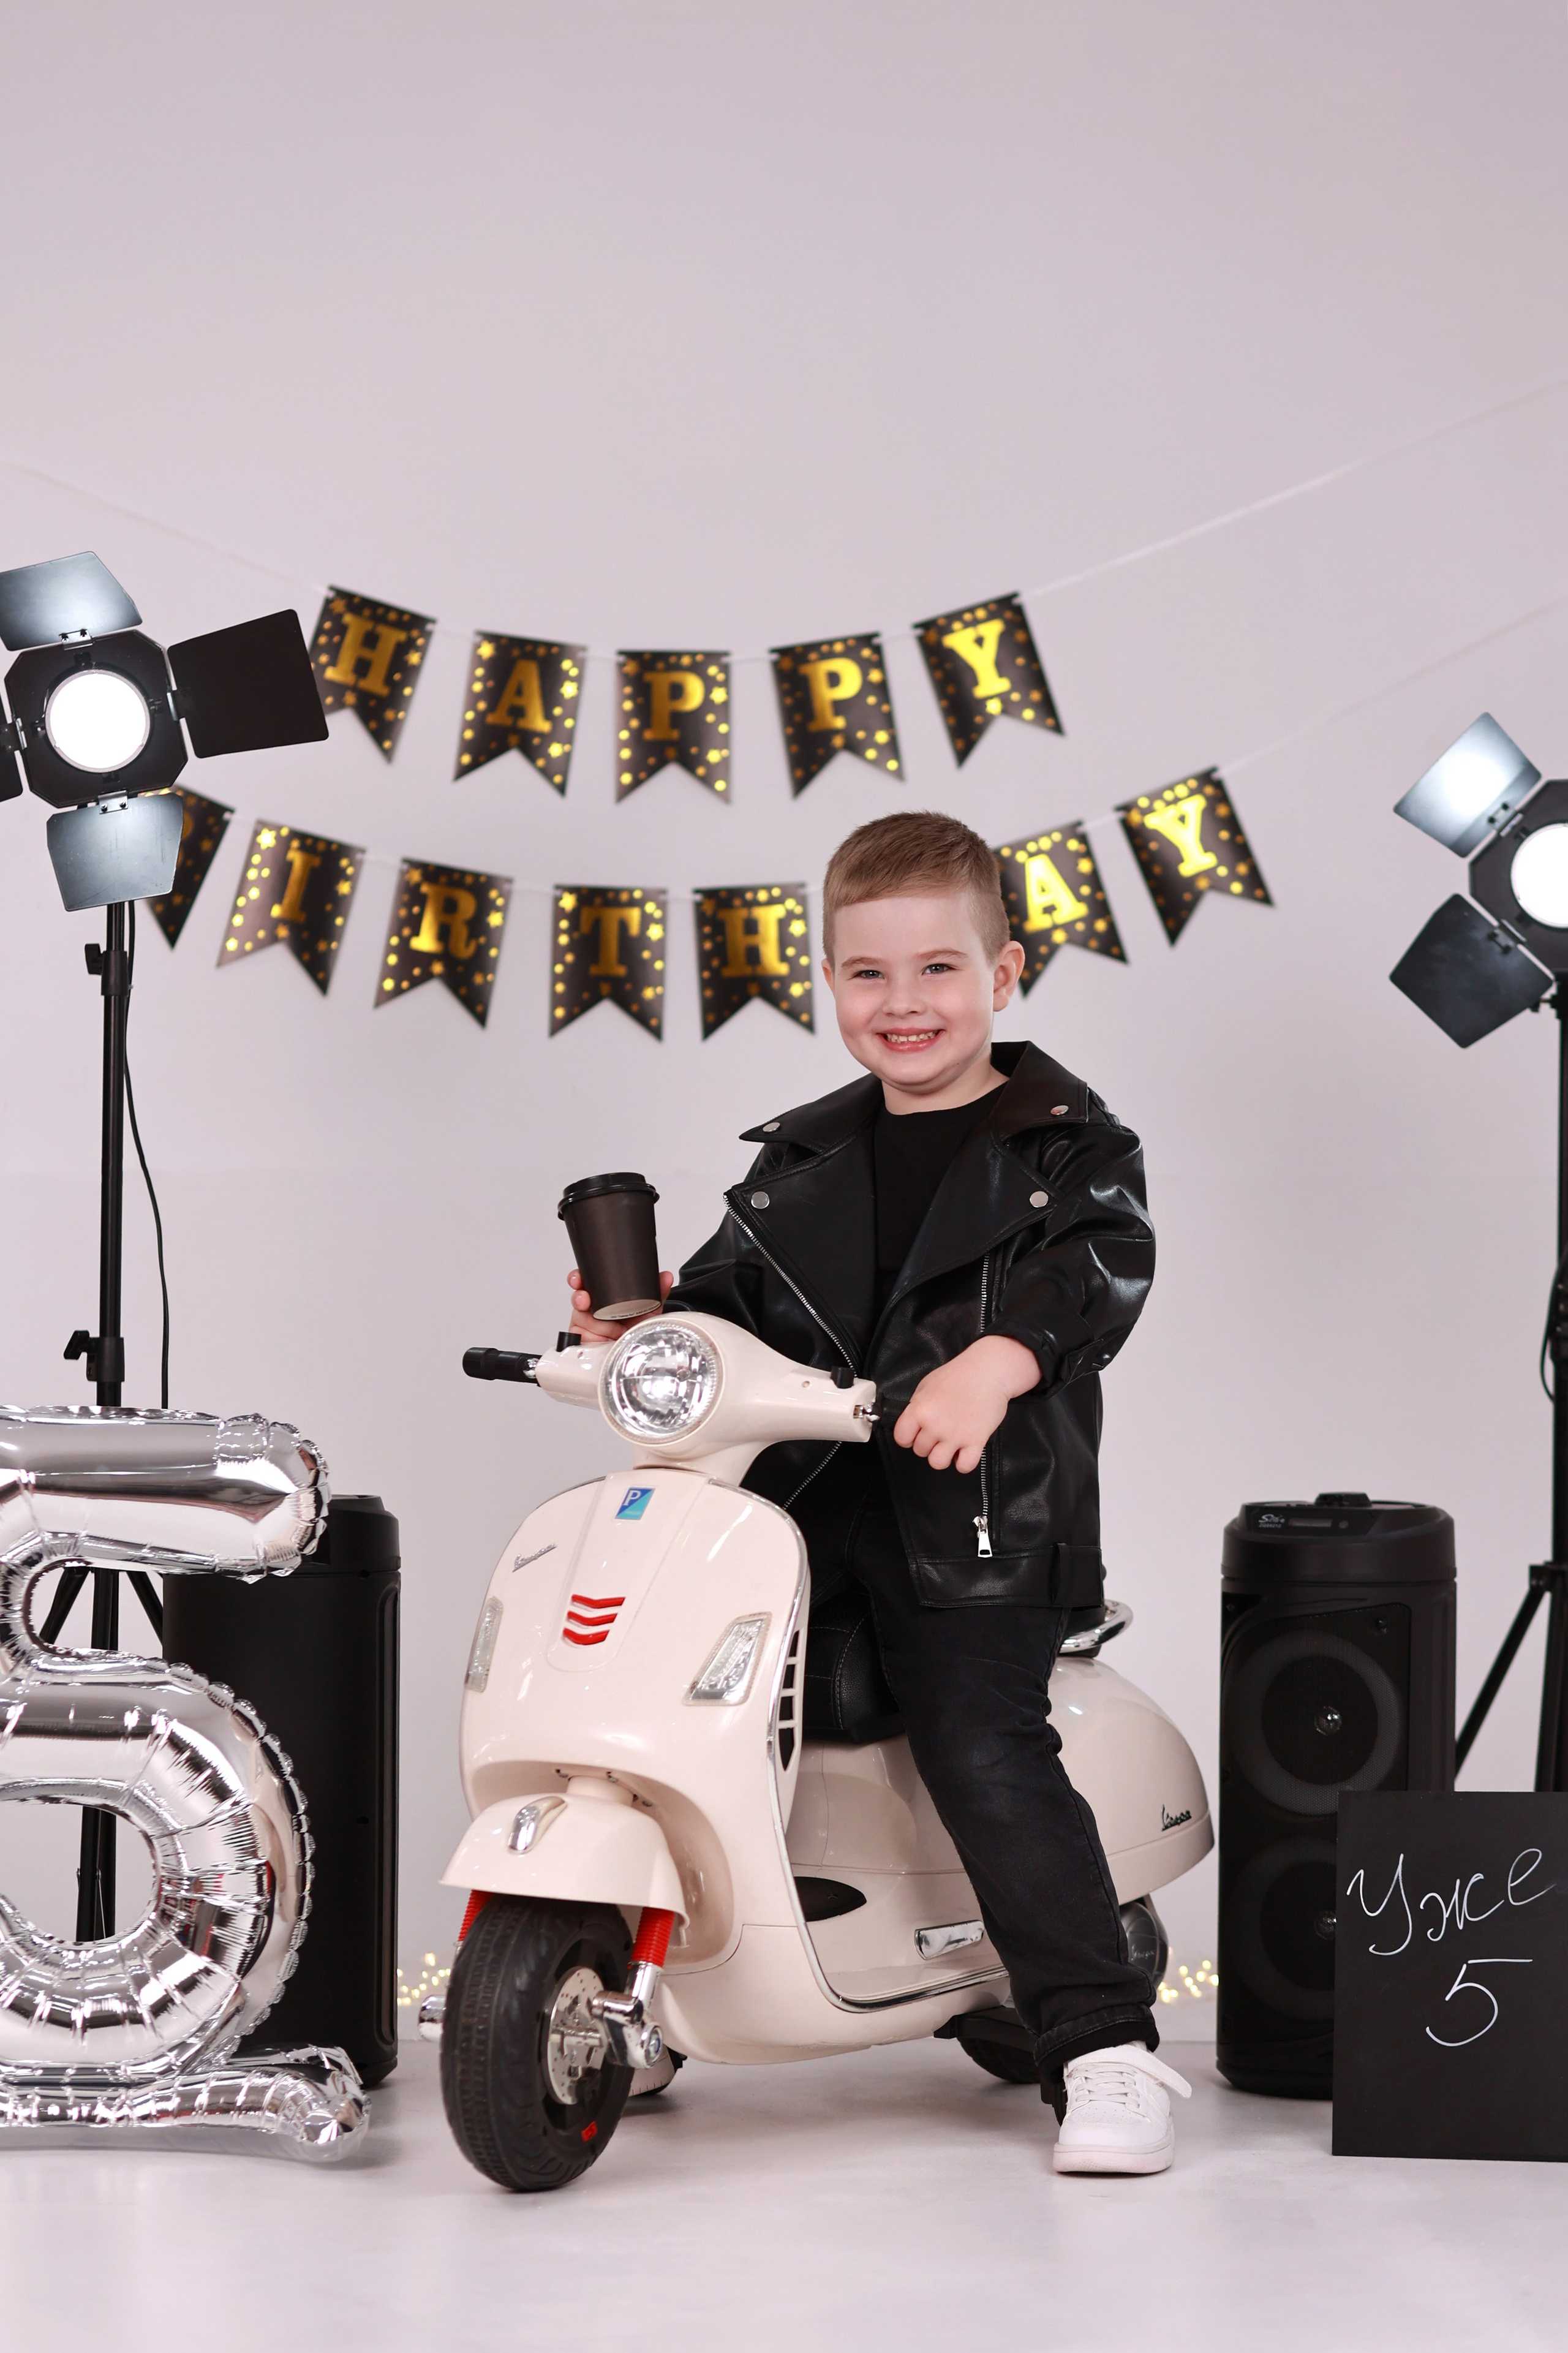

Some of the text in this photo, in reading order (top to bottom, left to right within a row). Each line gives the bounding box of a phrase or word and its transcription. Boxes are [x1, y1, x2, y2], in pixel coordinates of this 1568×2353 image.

[323, 613, 1011, 740] HAPPY
[181, 794, 1218, 976] IRTHAY
[622, 1490, 641, 1506] P
[1346, 1848, 1556, 1955] Уже
[1425, 1958, 1533, 2047] 5
